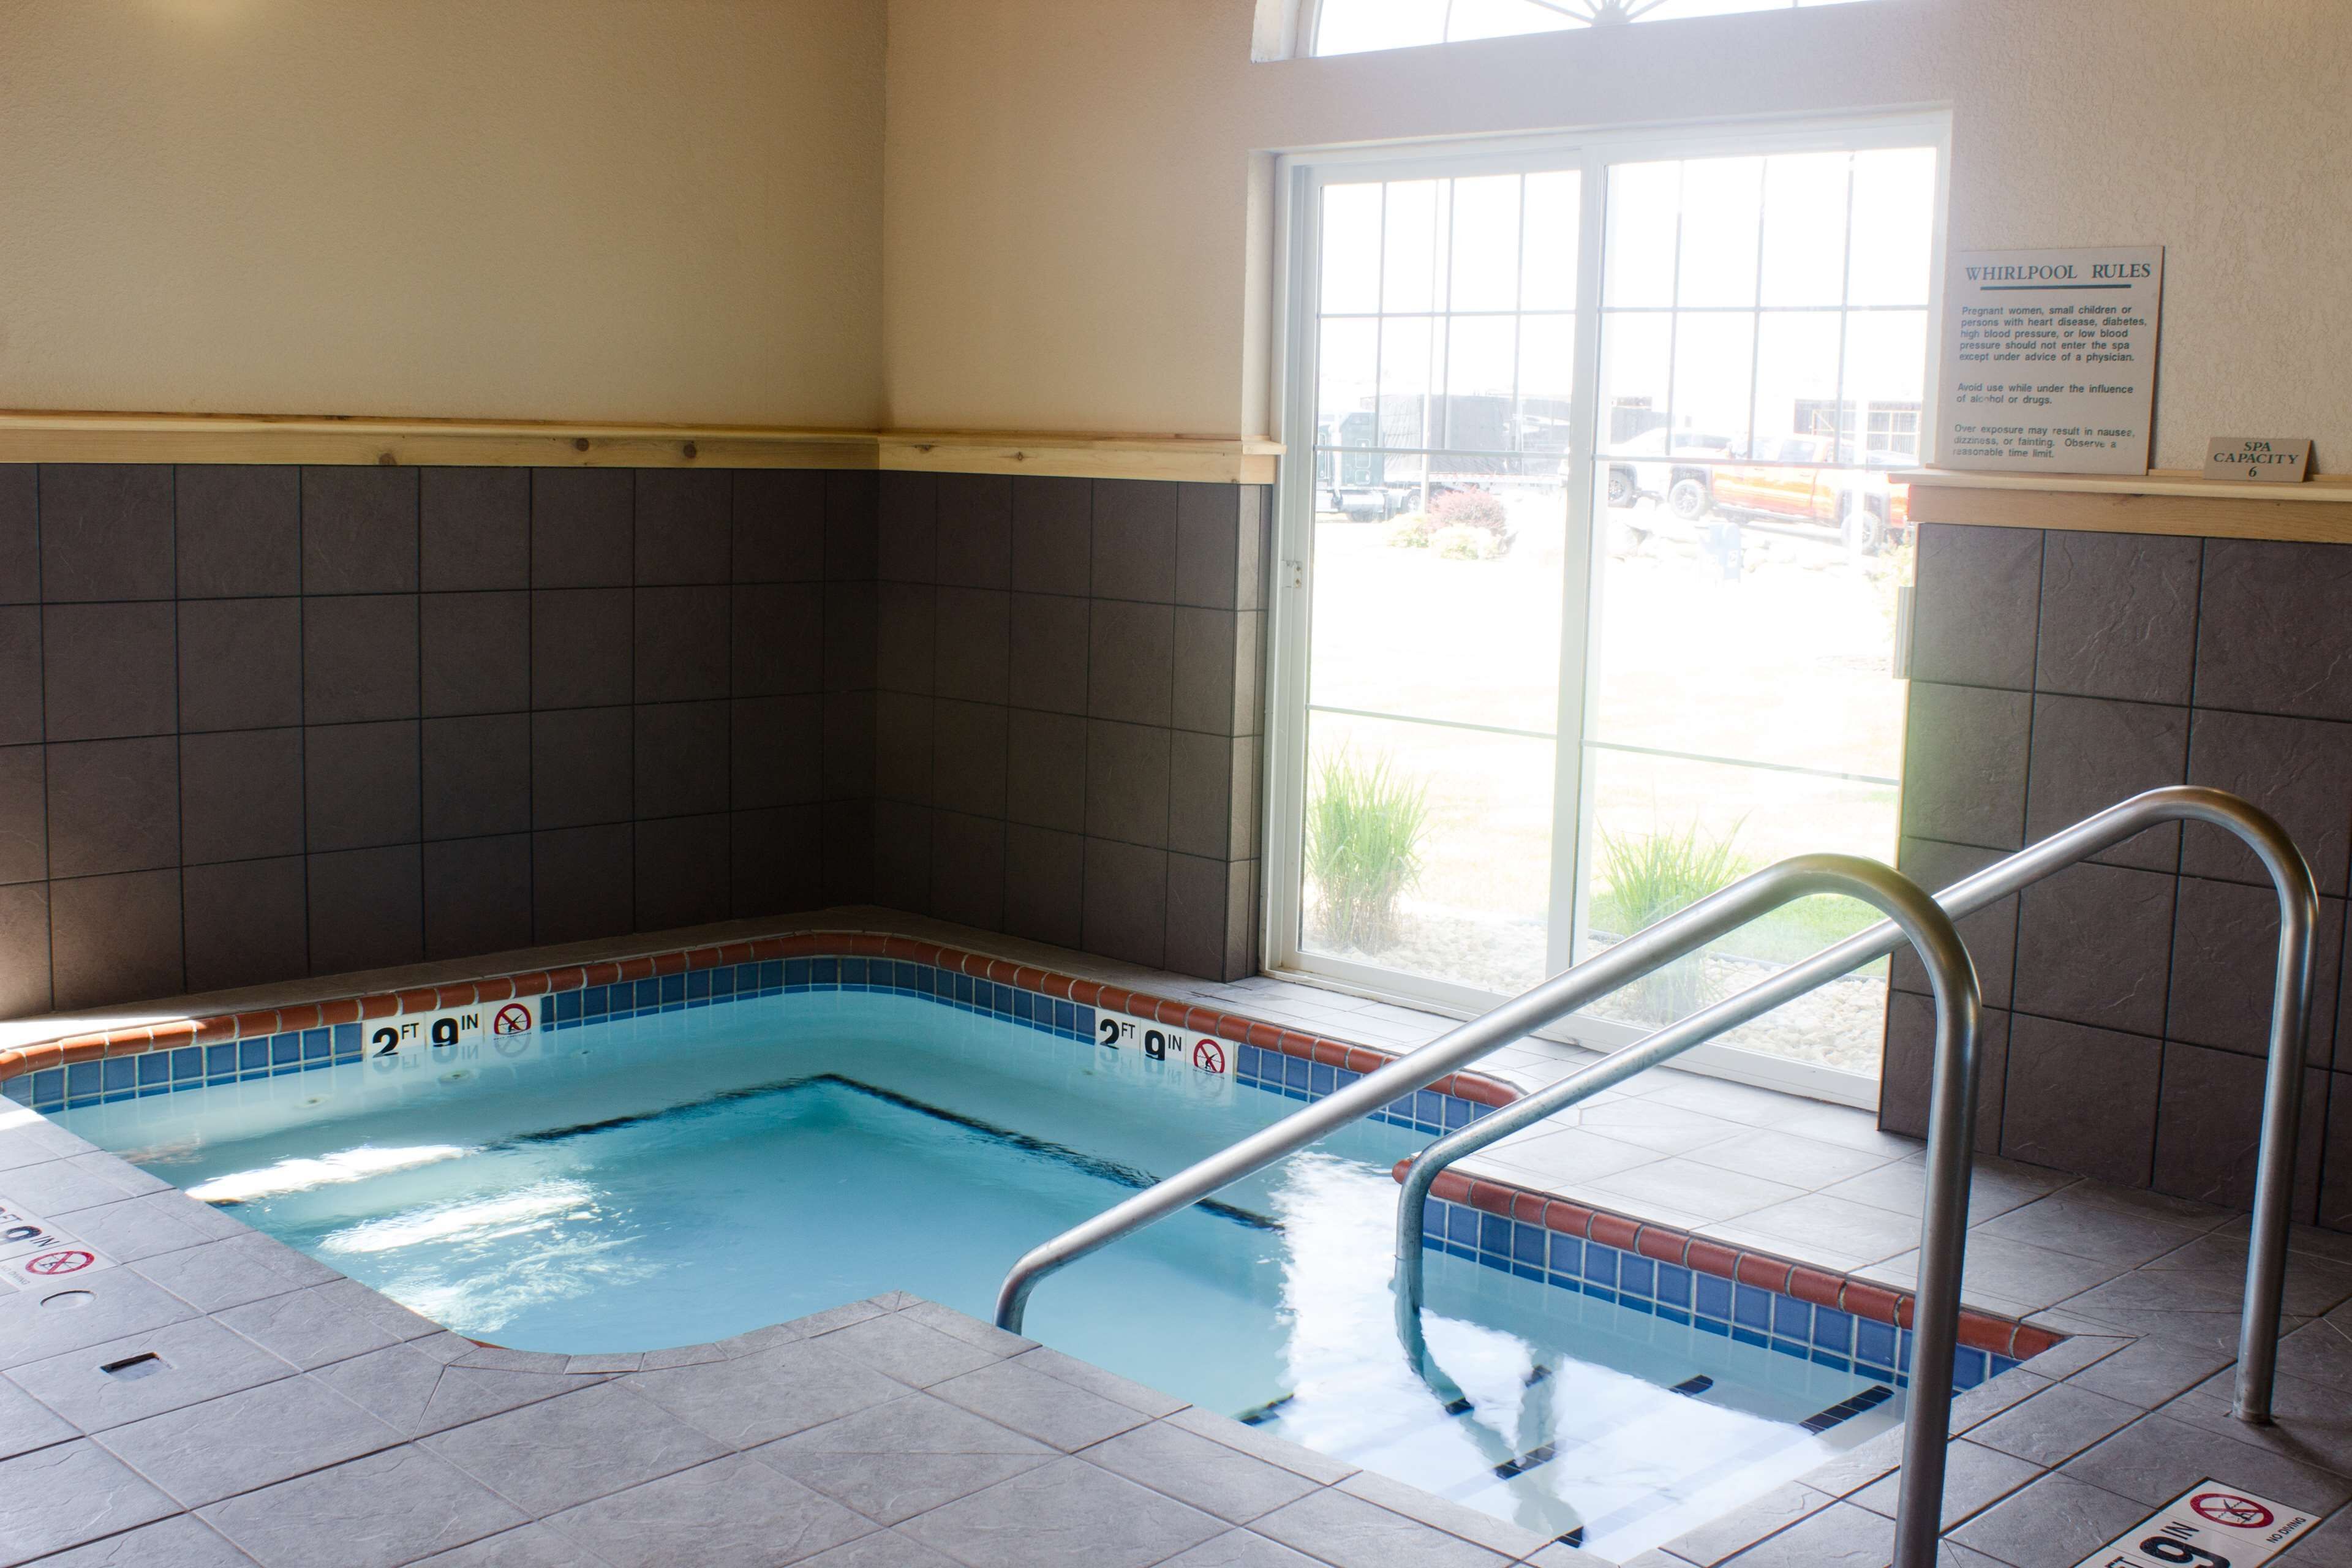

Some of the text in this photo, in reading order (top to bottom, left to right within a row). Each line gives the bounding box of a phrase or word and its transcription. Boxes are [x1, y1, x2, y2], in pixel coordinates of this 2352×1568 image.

[1965, 263, 2150, 281] WHIRLPOOL RULES
[1962, 306, 2003, 317] Pregnant
[2078, 306, 2117, 314] children
[1961, 317, 2147, 328] persons with heart disease, diabetes,
[1960, 330, 1980, 339] high
[2079, 329, 2095, 337] low
[2100, 329, 2128, 337] blood
[1959, 342, 2000, 351] pressure
[2005, 341, 2036, 349] should
[2092, 341, 2107, 349] the
[2112, 342, 2130, 351] spa
[1959, 353, 1989, 363] except
[2086, 353, 2135, 363] physician.
[1958, 383, 1983, 391] Avoid
[2069, 384, 2084, 393] the
[2089, 385, 2134, 393] influence
[2023, 395, 2052, 405] drugs.
[1954, 424, 1977, 432] Over
[1981, 426, 2024, 435] exposure
[2028, 427, 2048, 436] may
[2052, 427, 2079, 435] result
[1954, 436, 1999, 446] dizziness,
[2018, 437, 2055, 448] fainting.
[2065, 438, 2105, 448] Observe
[2244, 441, 2271, 451] SPA
[2008, 448, 2029, 458] time
[2033, 450, 2054, 458] limit.
[2214, 453, 2300, 464] CAPACITY
[2248, 466, 2258, 477] 6
[372, 1013, 478, 1058] 2 FT 9 IN
[1099, 1019, 1182, 1061] 2 FT 9 IN
[29, 1235, 61, 1247] IN
[2160, 1521, 2200, 1540] IN
[2266, 1517, 2307, 1544] NO DIVING
[2139, 1536, 2231, 1568] 9
